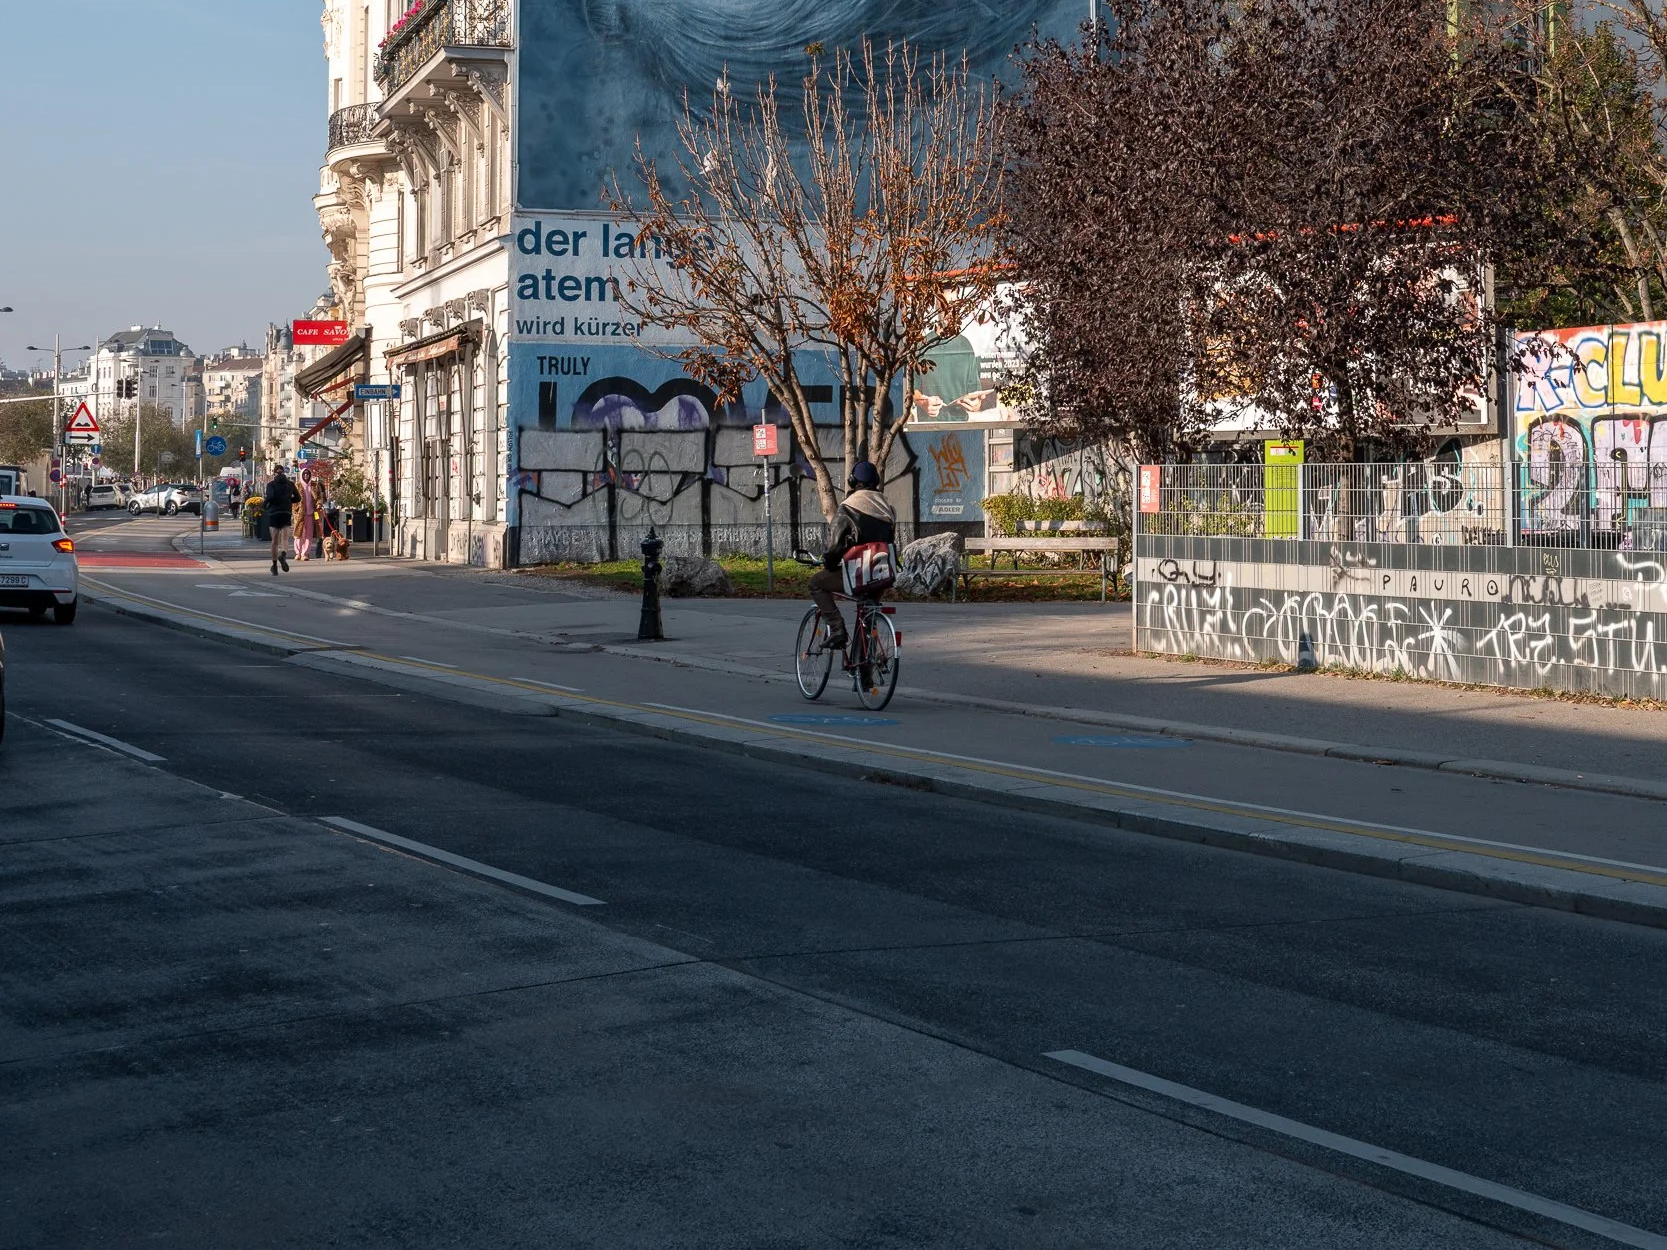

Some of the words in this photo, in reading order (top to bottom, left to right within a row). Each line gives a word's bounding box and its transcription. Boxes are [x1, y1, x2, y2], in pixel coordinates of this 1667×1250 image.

[517, 220, 587, 257] der
[517, 268, 620, 302] atem
[297, 328, 319, 336] CAFE
[323, 328, 349, 336] SAVO
[516, 316, 565, 336] wird
[574, 317, 642, 337] kürzer
[537, 355, 591, 376] TRULY
[360, 388, 386, 396] EINBAHN
